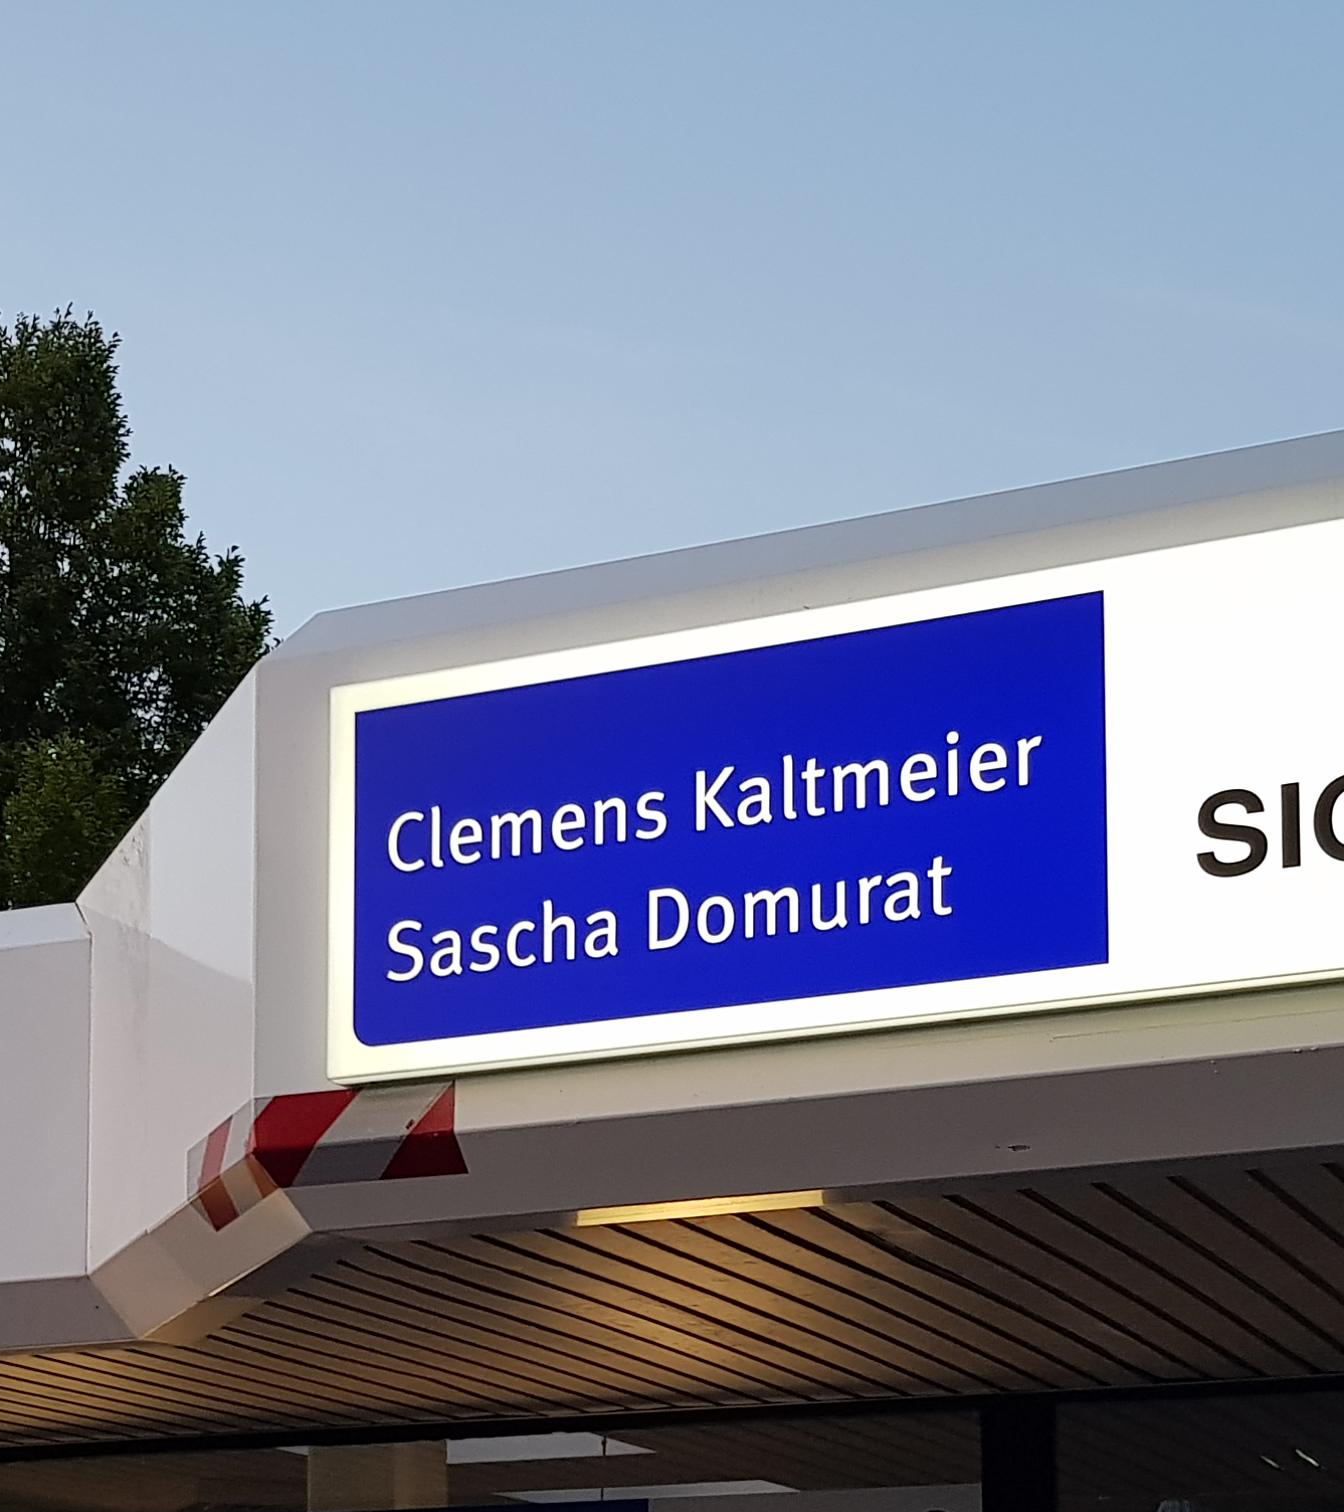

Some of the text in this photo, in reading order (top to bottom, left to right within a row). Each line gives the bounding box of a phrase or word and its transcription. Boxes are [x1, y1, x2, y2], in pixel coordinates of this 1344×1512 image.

[387, 730, 1043, 874] Clemens Kaltmeier
[386, 854, 953, 983] Sascha Domurat
